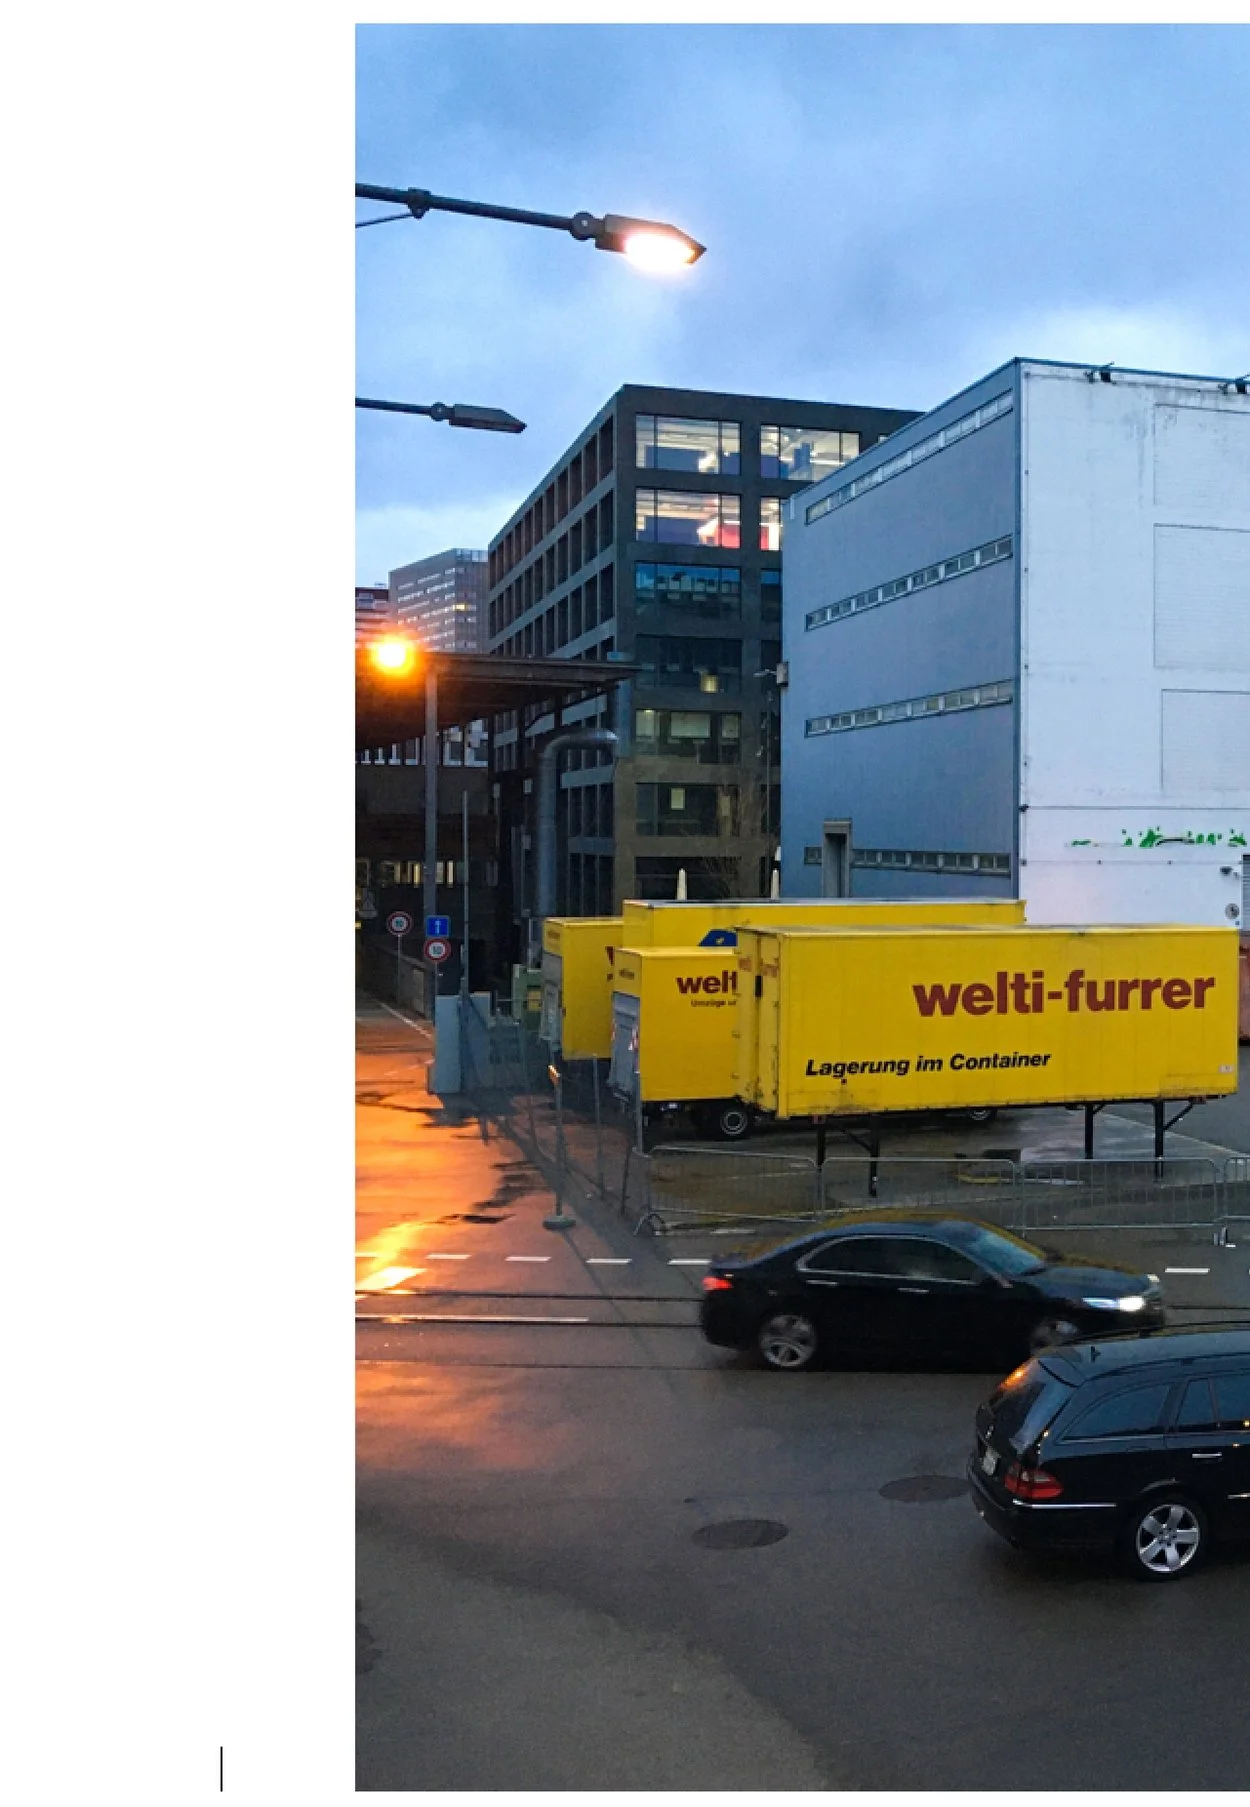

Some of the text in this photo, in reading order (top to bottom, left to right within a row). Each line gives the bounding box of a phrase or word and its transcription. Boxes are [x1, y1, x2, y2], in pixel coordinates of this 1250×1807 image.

[912, 969, 1215, 1017] welti-furrer
[805, 1051, 1051, 1077] Lagerung im Container
